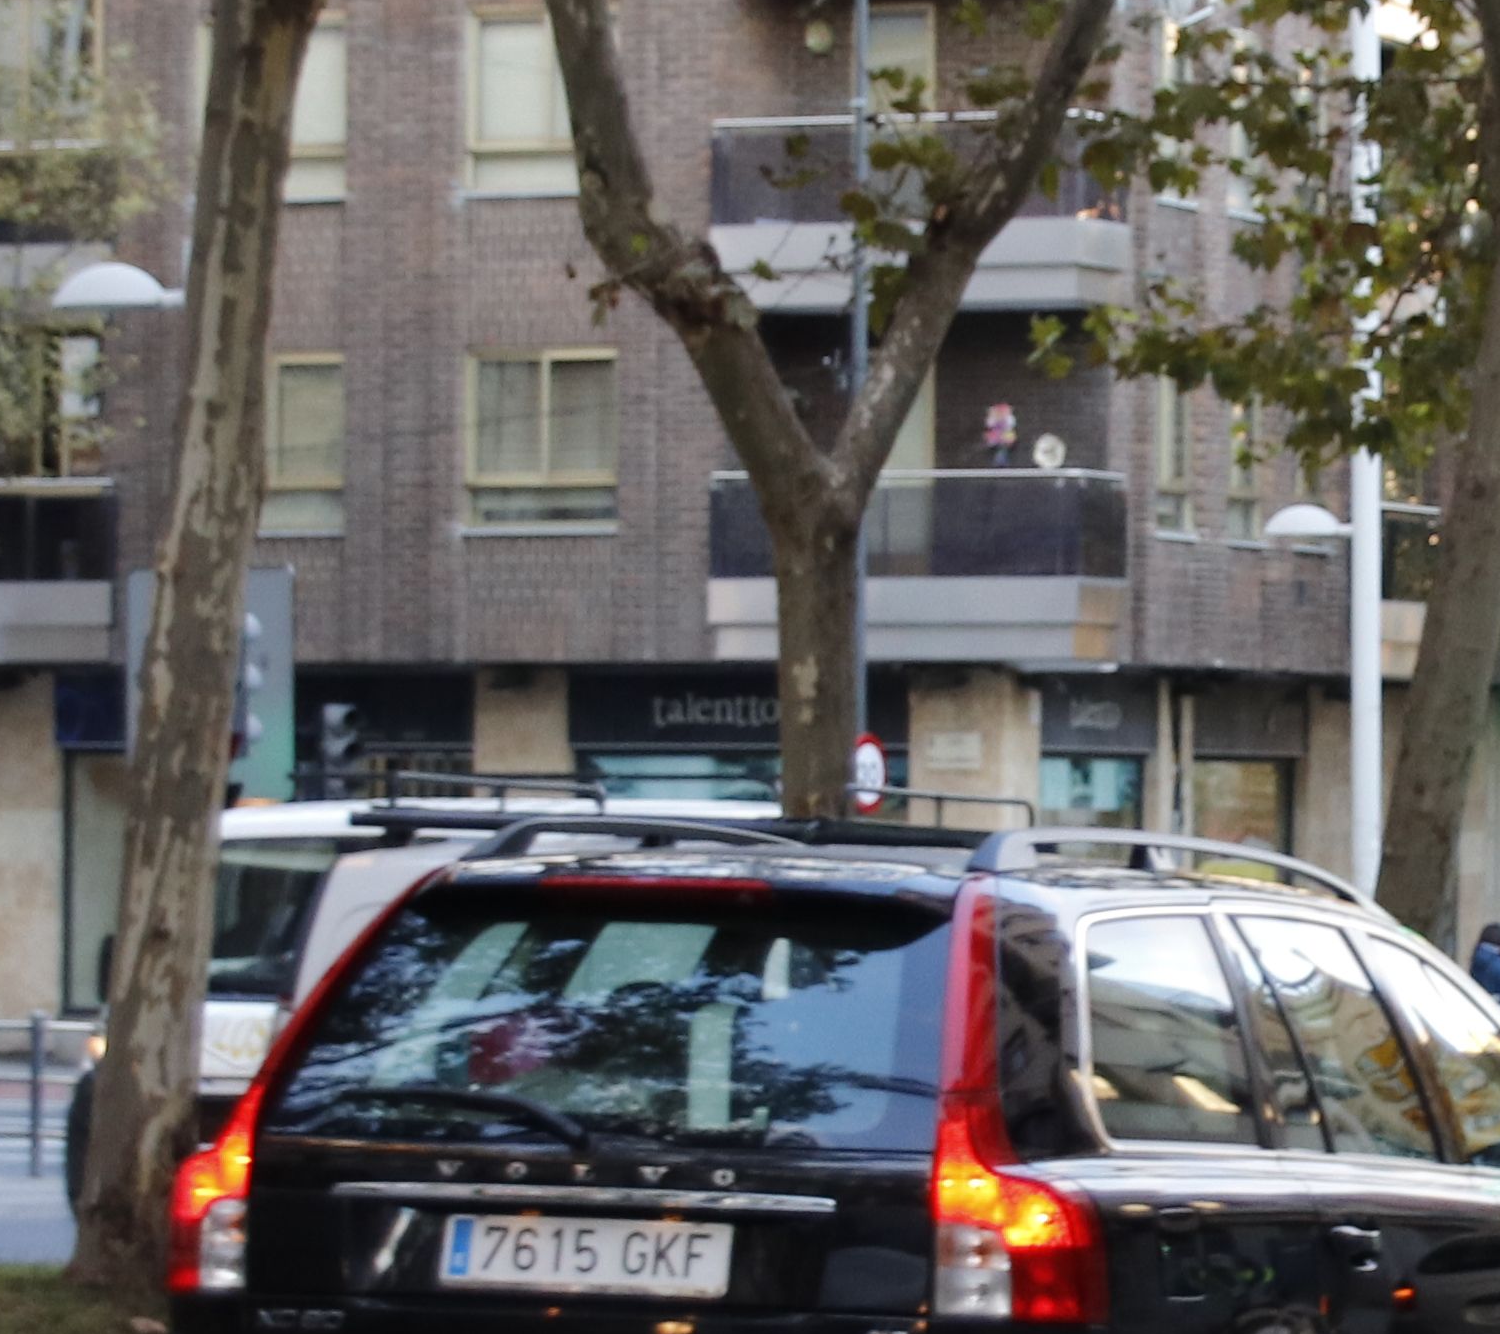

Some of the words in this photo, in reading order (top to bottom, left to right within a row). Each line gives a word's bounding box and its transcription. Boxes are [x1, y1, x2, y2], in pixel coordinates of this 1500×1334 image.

[436, 1159, 736, 1187] VOLVO
[480, 1225, 599, 1273] 7615
[622, 1230, 712, 1278] GKF
